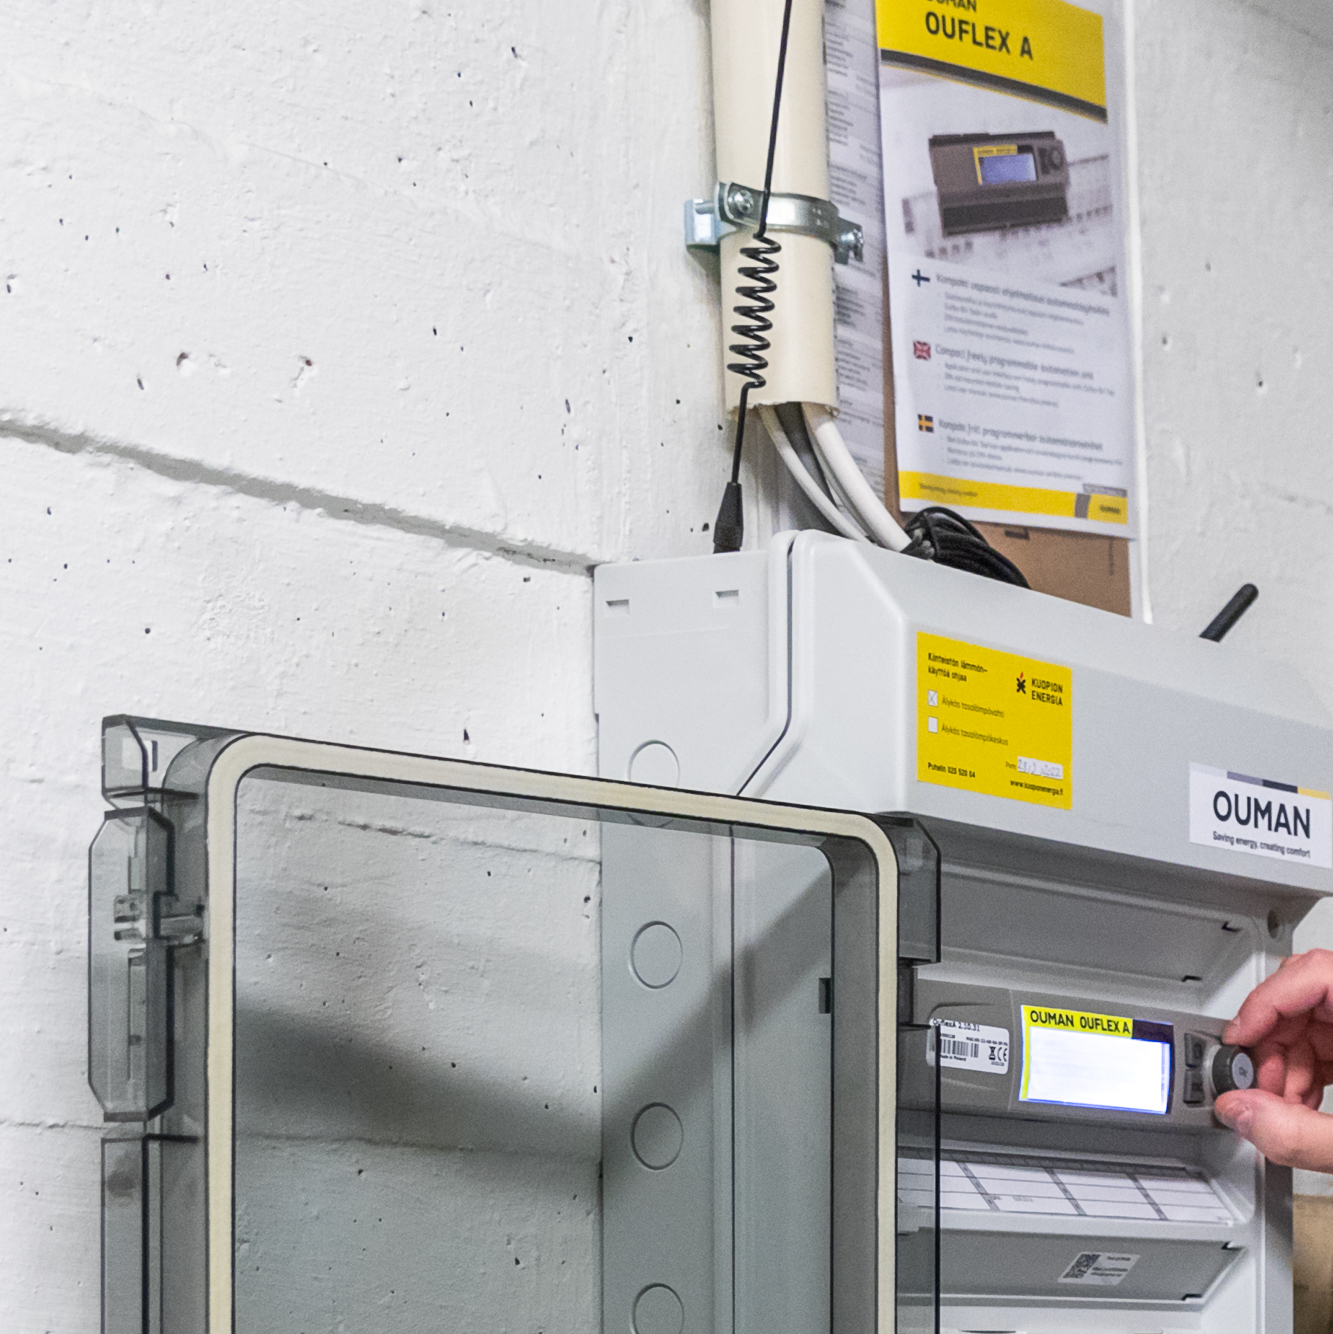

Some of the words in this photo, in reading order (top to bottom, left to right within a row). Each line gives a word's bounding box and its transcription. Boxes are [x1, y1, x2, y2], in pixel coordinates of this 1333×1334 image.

[925, 11, 1011, 54] OUFLEX
[1020, 36, 1034, 60] A
[1031, 677, 1064, 694] KUOPION
[1031, 690, 1064, 707] ENERGIA
[1212, 790, 1310, 839] OUMAN
[1212, 830, 1235, 846] Saving
[1236, 837, 1258, 850] energy,
[1260, 841, 1285, 855] creating
[1286, 847, 1311, 859] comfort
[1029, 1009, 1075, 1028] OUMAN
[1079, 1015, 1120, 1033] OUFLEX
[1122, 1022, 1131, 1035] A
